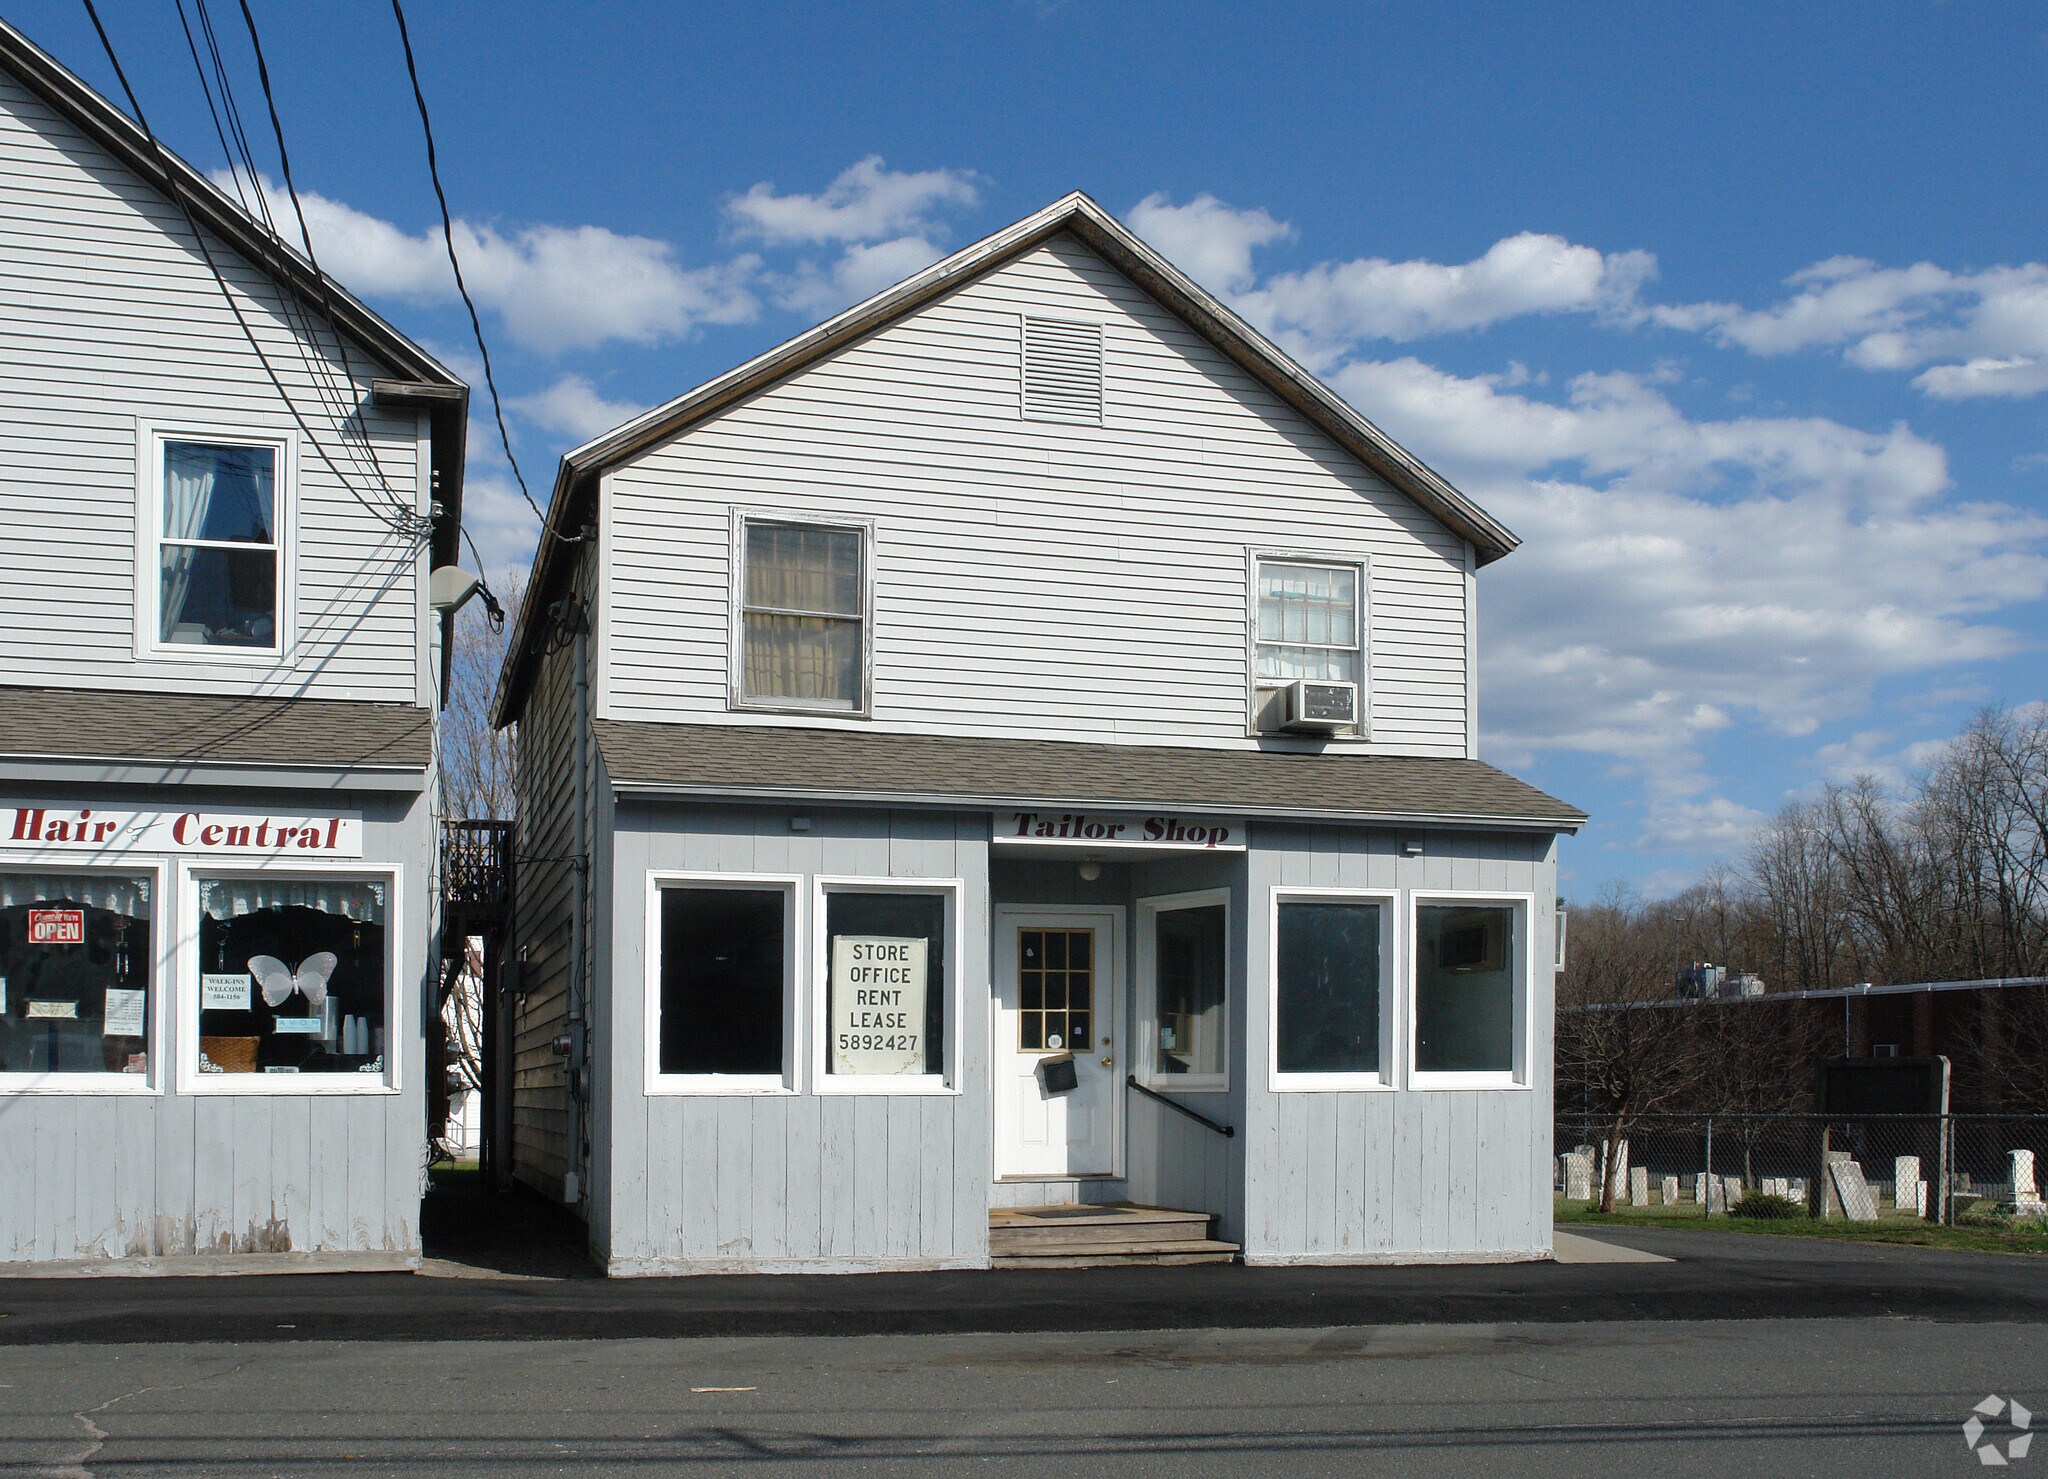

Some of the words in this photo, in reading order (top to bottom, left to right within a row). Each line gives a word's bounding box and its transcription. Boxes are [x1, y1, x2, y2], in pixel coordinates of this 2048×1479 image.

[9, 809, 116, 843] Hair
[172, 811, 340, 849] Central
[1012, 812, 1126, 839] Tailor
[1143, 817, 1229, 848] Shop
[34, 922, 79, 940] OPEN
[852, 944, 909, 961] STORE
[850, 967, 911, 984] OFFICE
[857, 989, 902, 1006] RENT
[850, 1012, 907, 1029] LEASE
[839, 1034, 918, 1051] 5892427
